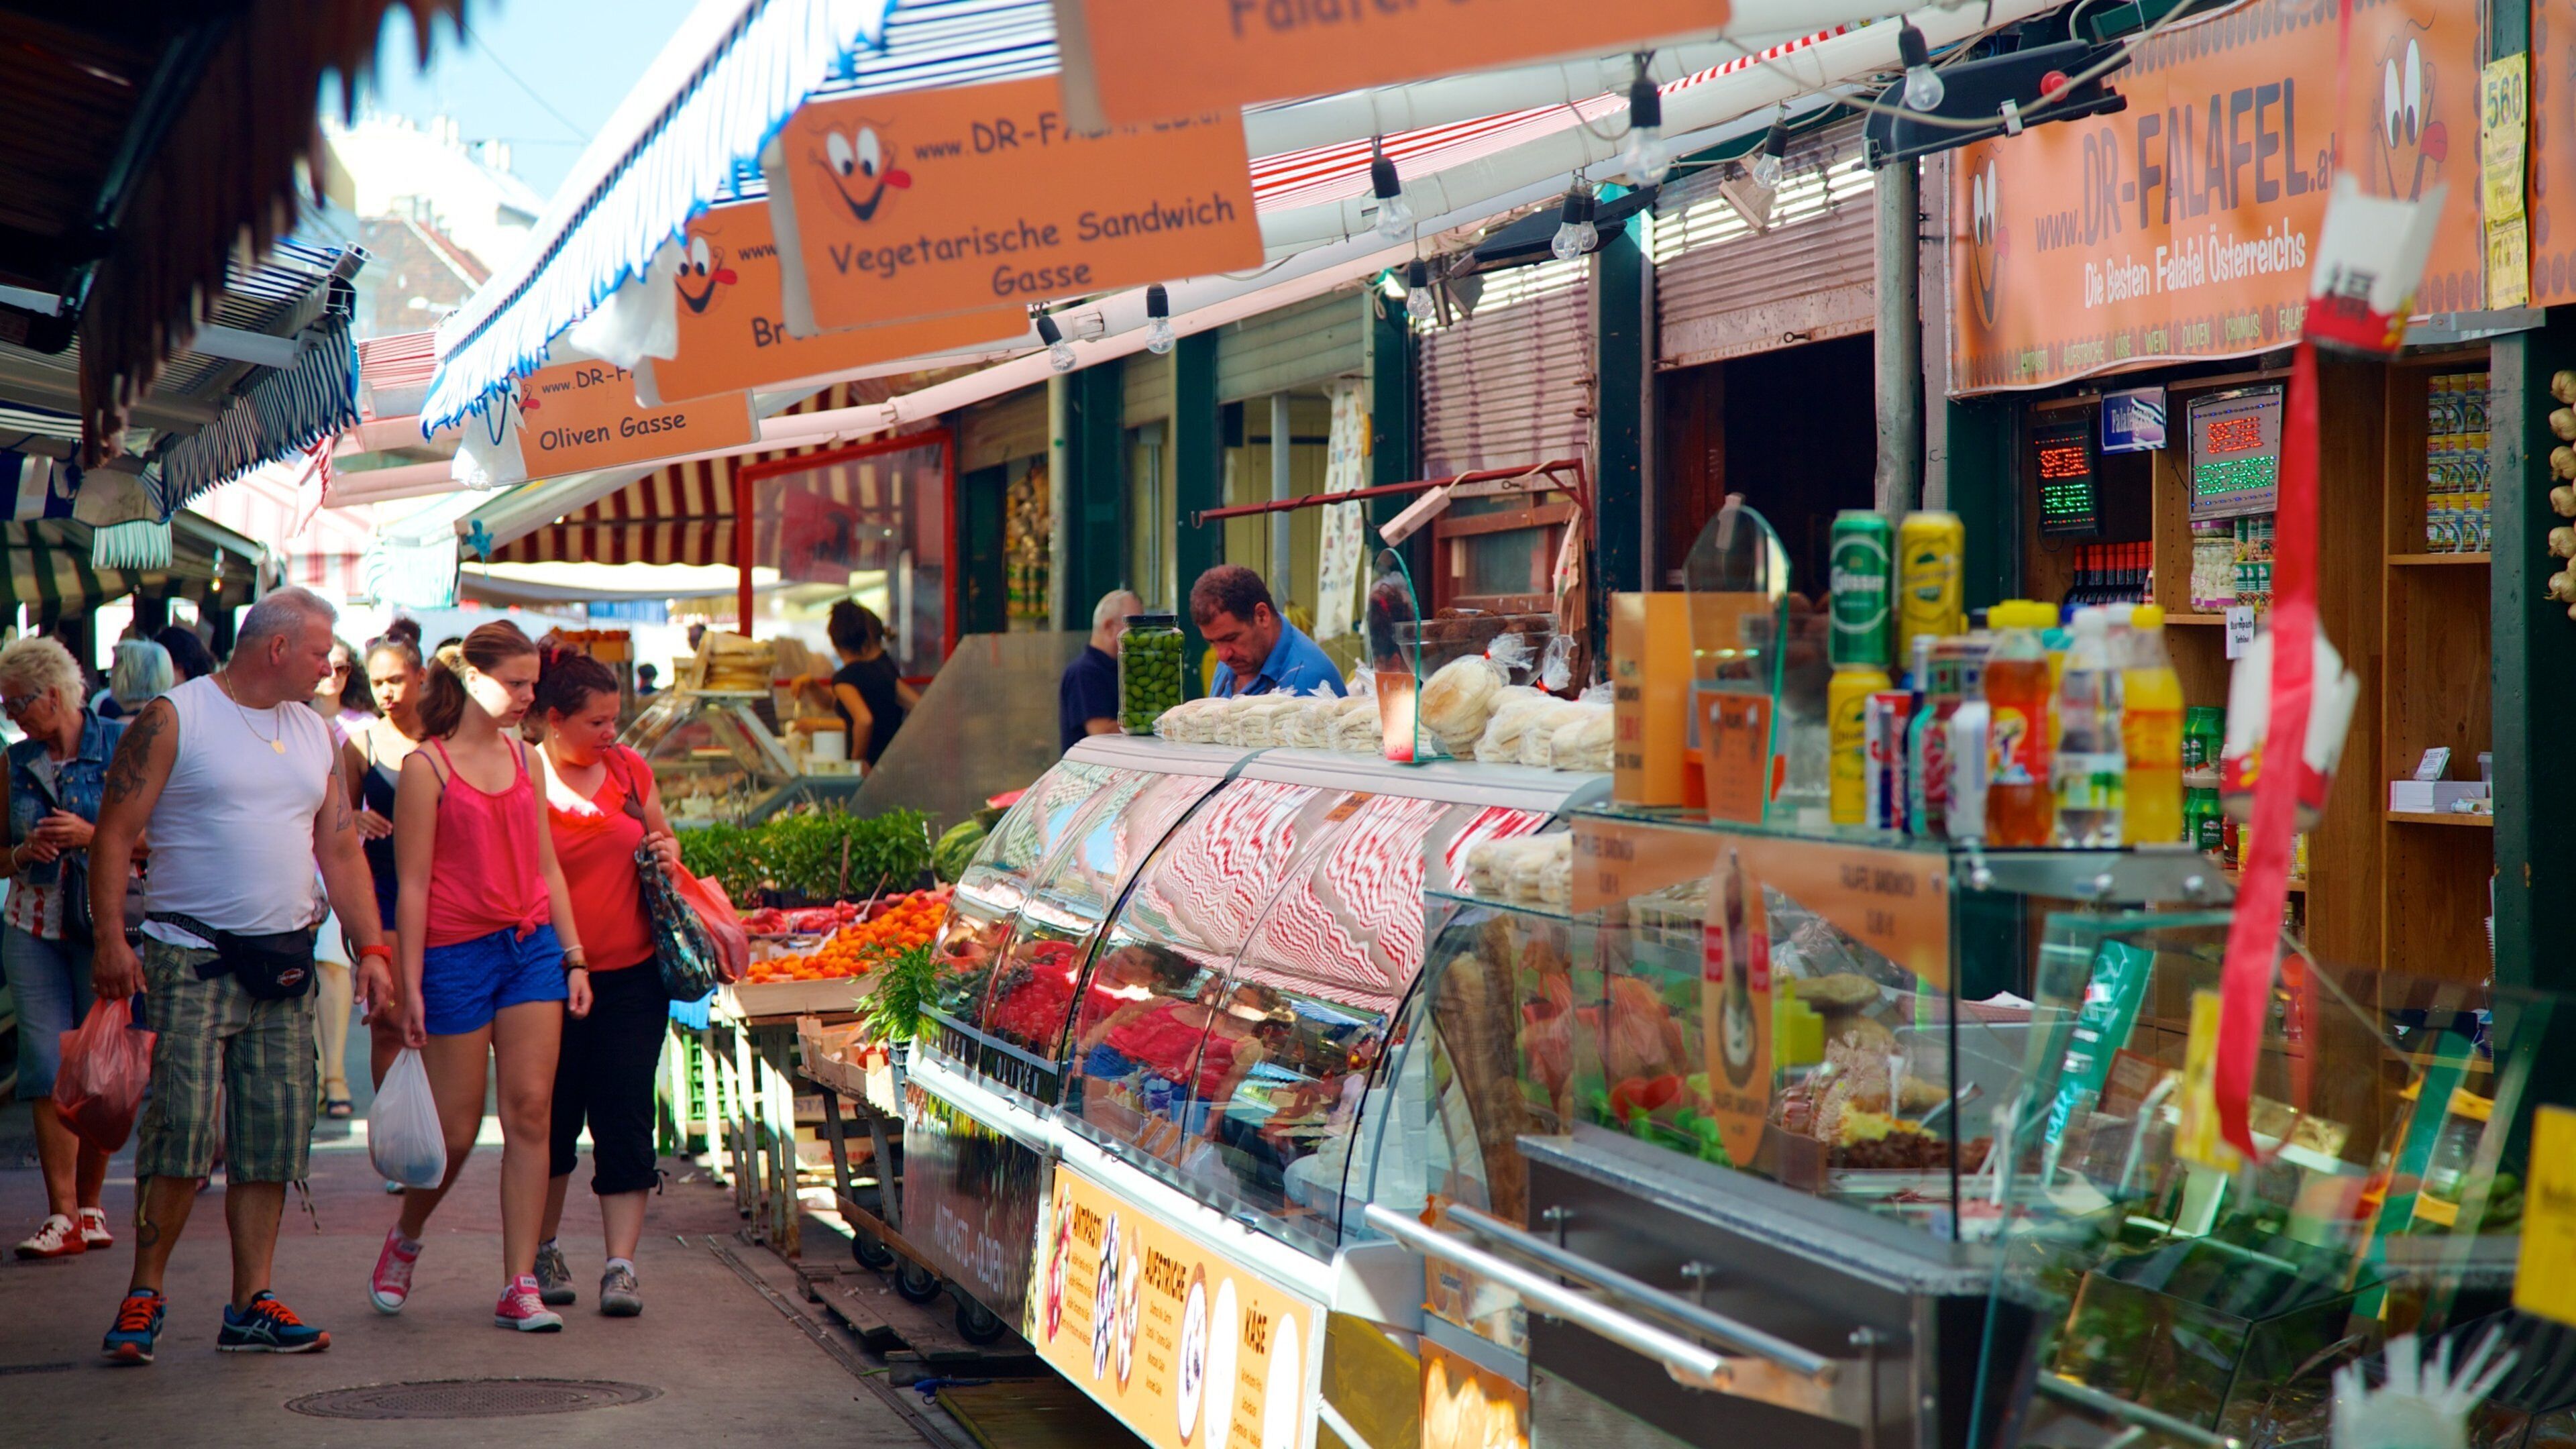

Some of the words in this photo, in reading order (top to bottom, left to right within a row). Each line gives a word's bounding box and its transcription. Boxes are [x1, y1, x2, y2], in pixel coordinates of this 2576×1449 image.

[2487, 72, 2521, 129] 560
[738, 244, 778, 260] www
[829, 219, 1059, 278] Vegetarische
[1078, 194, 1235, 241] Sandwich
[992, 263, 1092, 297] Gasse
[2085, 261, 2104, 309] Die
[2106, 254, 2150, 305] Besten
[2155, 235, 2205, 292] Falafel
[2209, 217, 2306, 283] Österreichs
[751, 317, 785, 347] Br
[2063, 340, 2104, 366] AUFSTRICHE
[2115, 335, 2131, 357] KÄSE
[2145, 329, 2167, 353] WEIN
[2183, 322, 2210, 348] OLIVEN
[2225, 314, 2259, 340] CHUMUS
[2279, 306, 2309, 333] FALAF
[542, 366, 632, 393] www.DR-F
[540, 425, 610, 451] Oliven
[619, 414, 687, 437] Gasse
[996, 1055, 1039, 1097] OLIVEN
[934, 1201, 969, 1268] ANTIPASTI
[976, 1230, 1004, 1295] OLIVEN
[1073, 1203, 1102, 1251] ANTIPASTI
[1144, 1246, 1187, 1303] AUFSTRICHE
[1244, 1299, 1267, 1355] KÄSE
